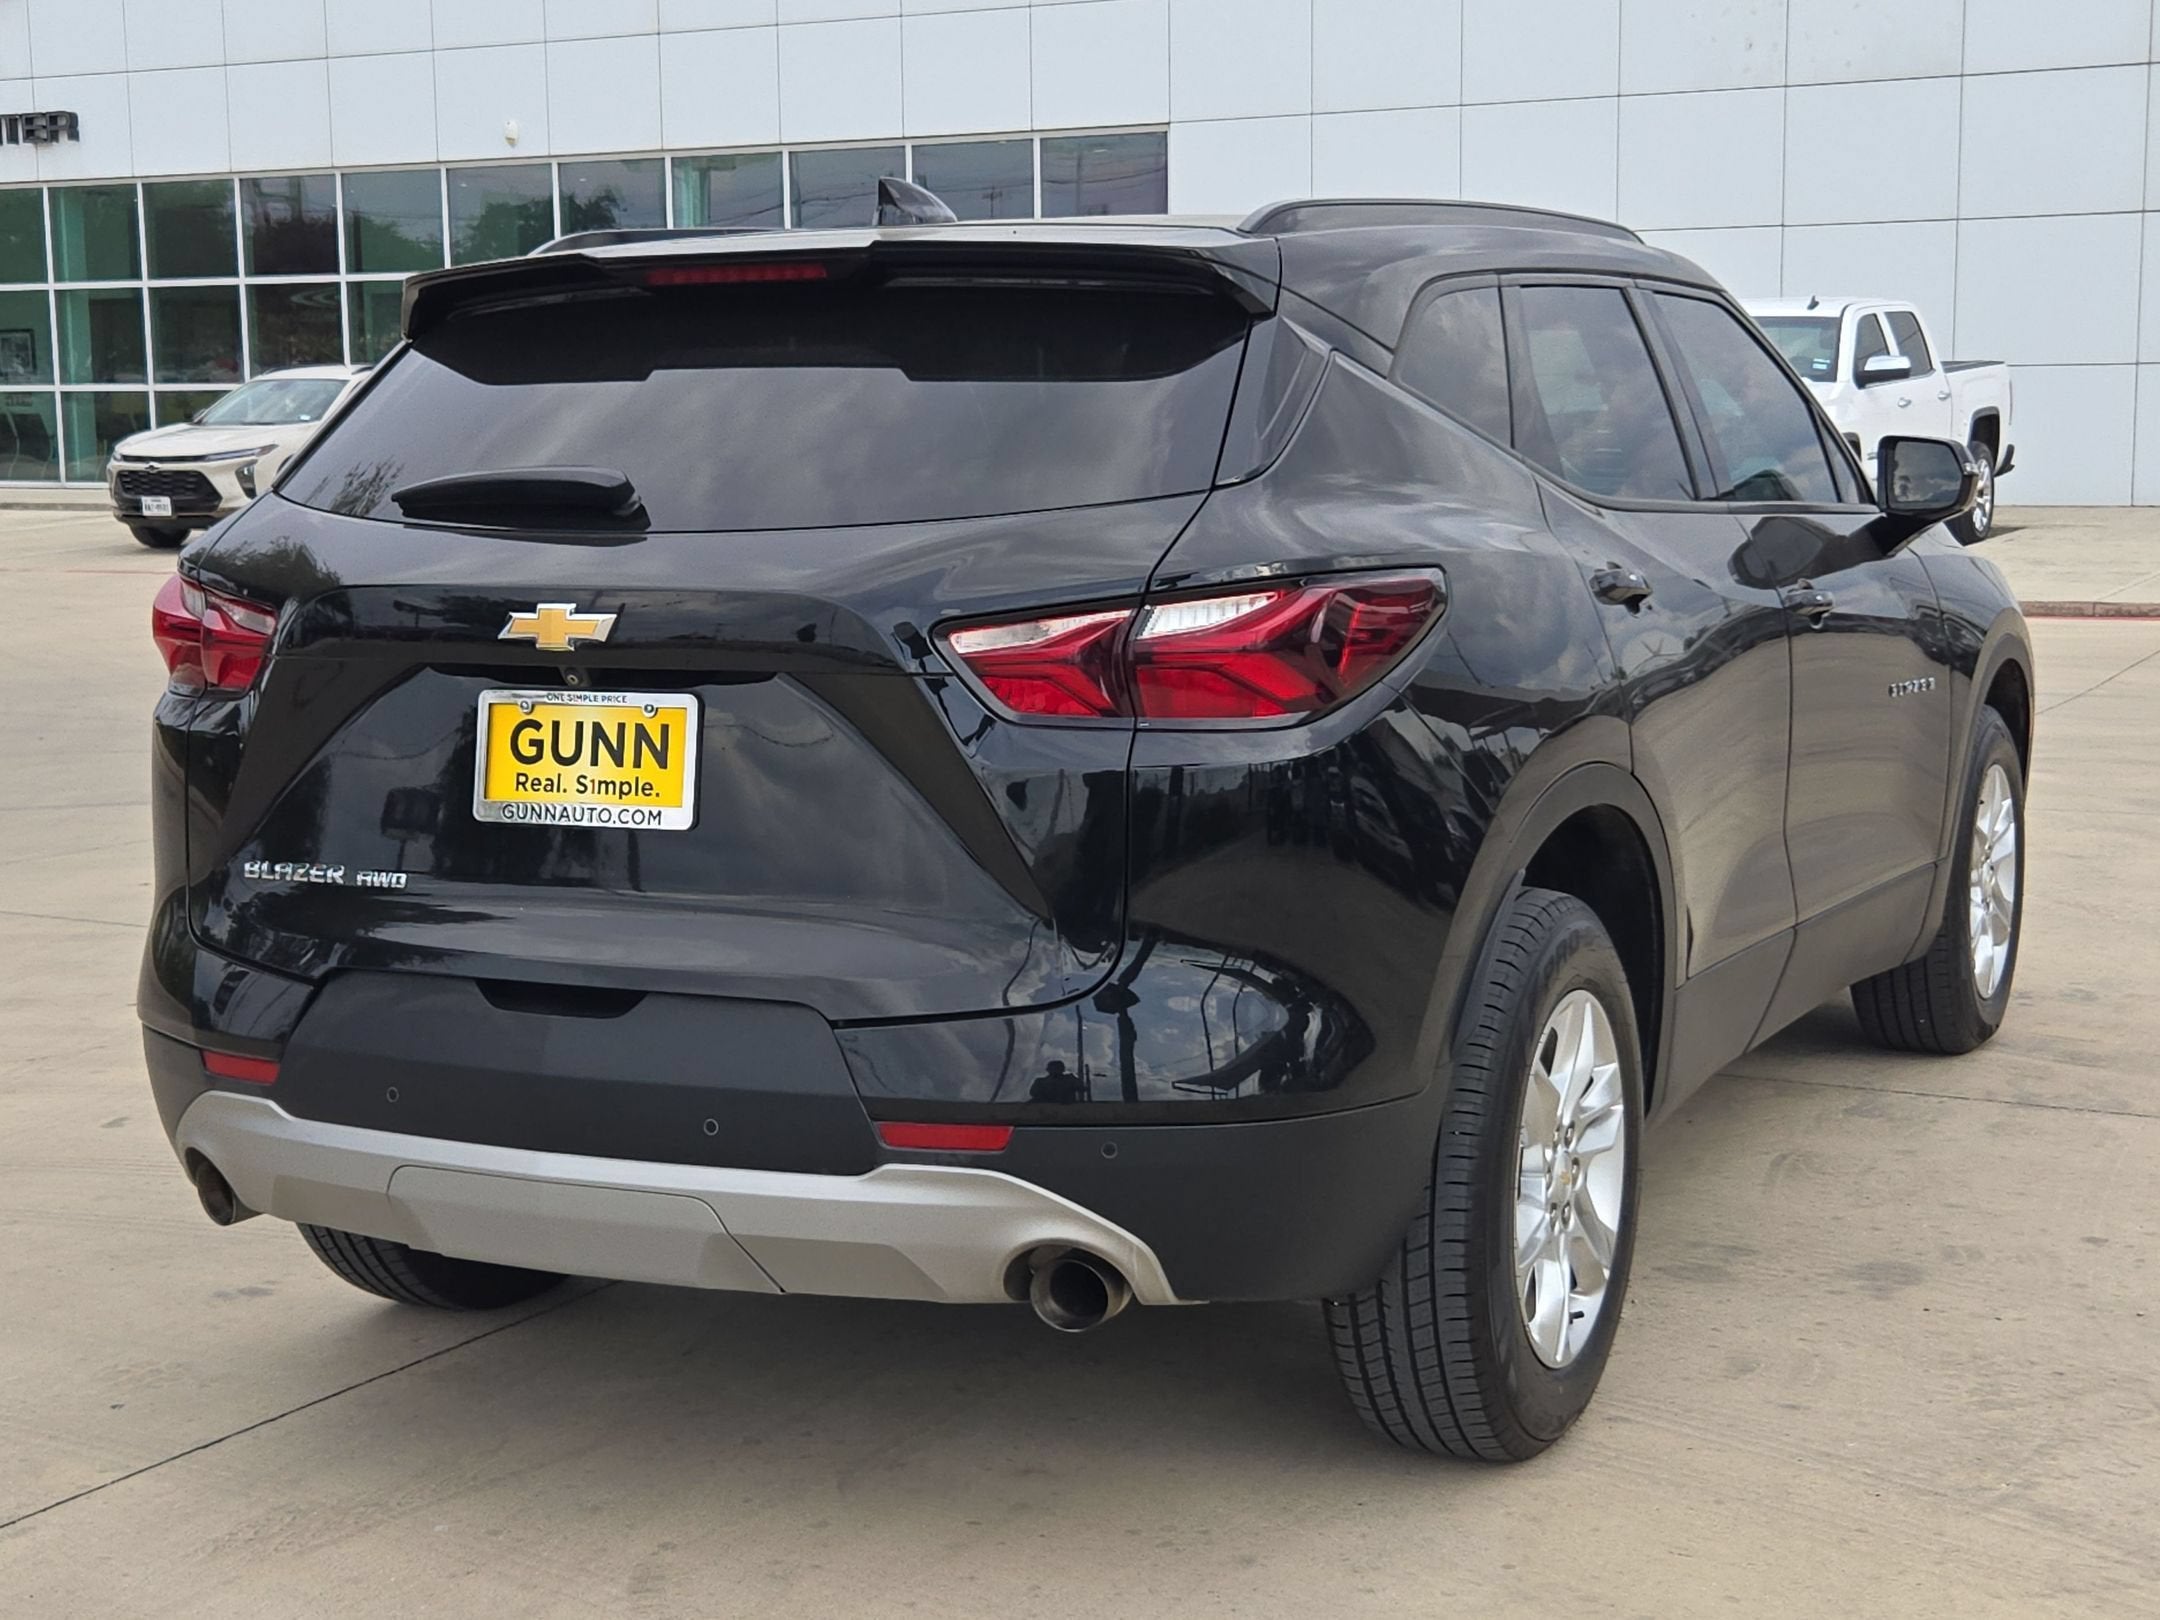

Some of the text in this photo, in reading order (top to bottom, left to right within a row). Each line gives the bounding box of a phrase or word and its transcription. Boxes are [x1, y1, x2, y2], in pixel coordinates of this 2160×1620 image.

[0, 111, 80, 146] TER
[546, 692, 564, 702] ONE
[601, 695, 627, 704] PRICE
[510, 718, 669, 770] GUNN
[515, 772, 567, 793] Real.
[502, 803, 662, 825] GUNNAUTO.COM
[244, 860, 407, 888] BLAZER AWD
